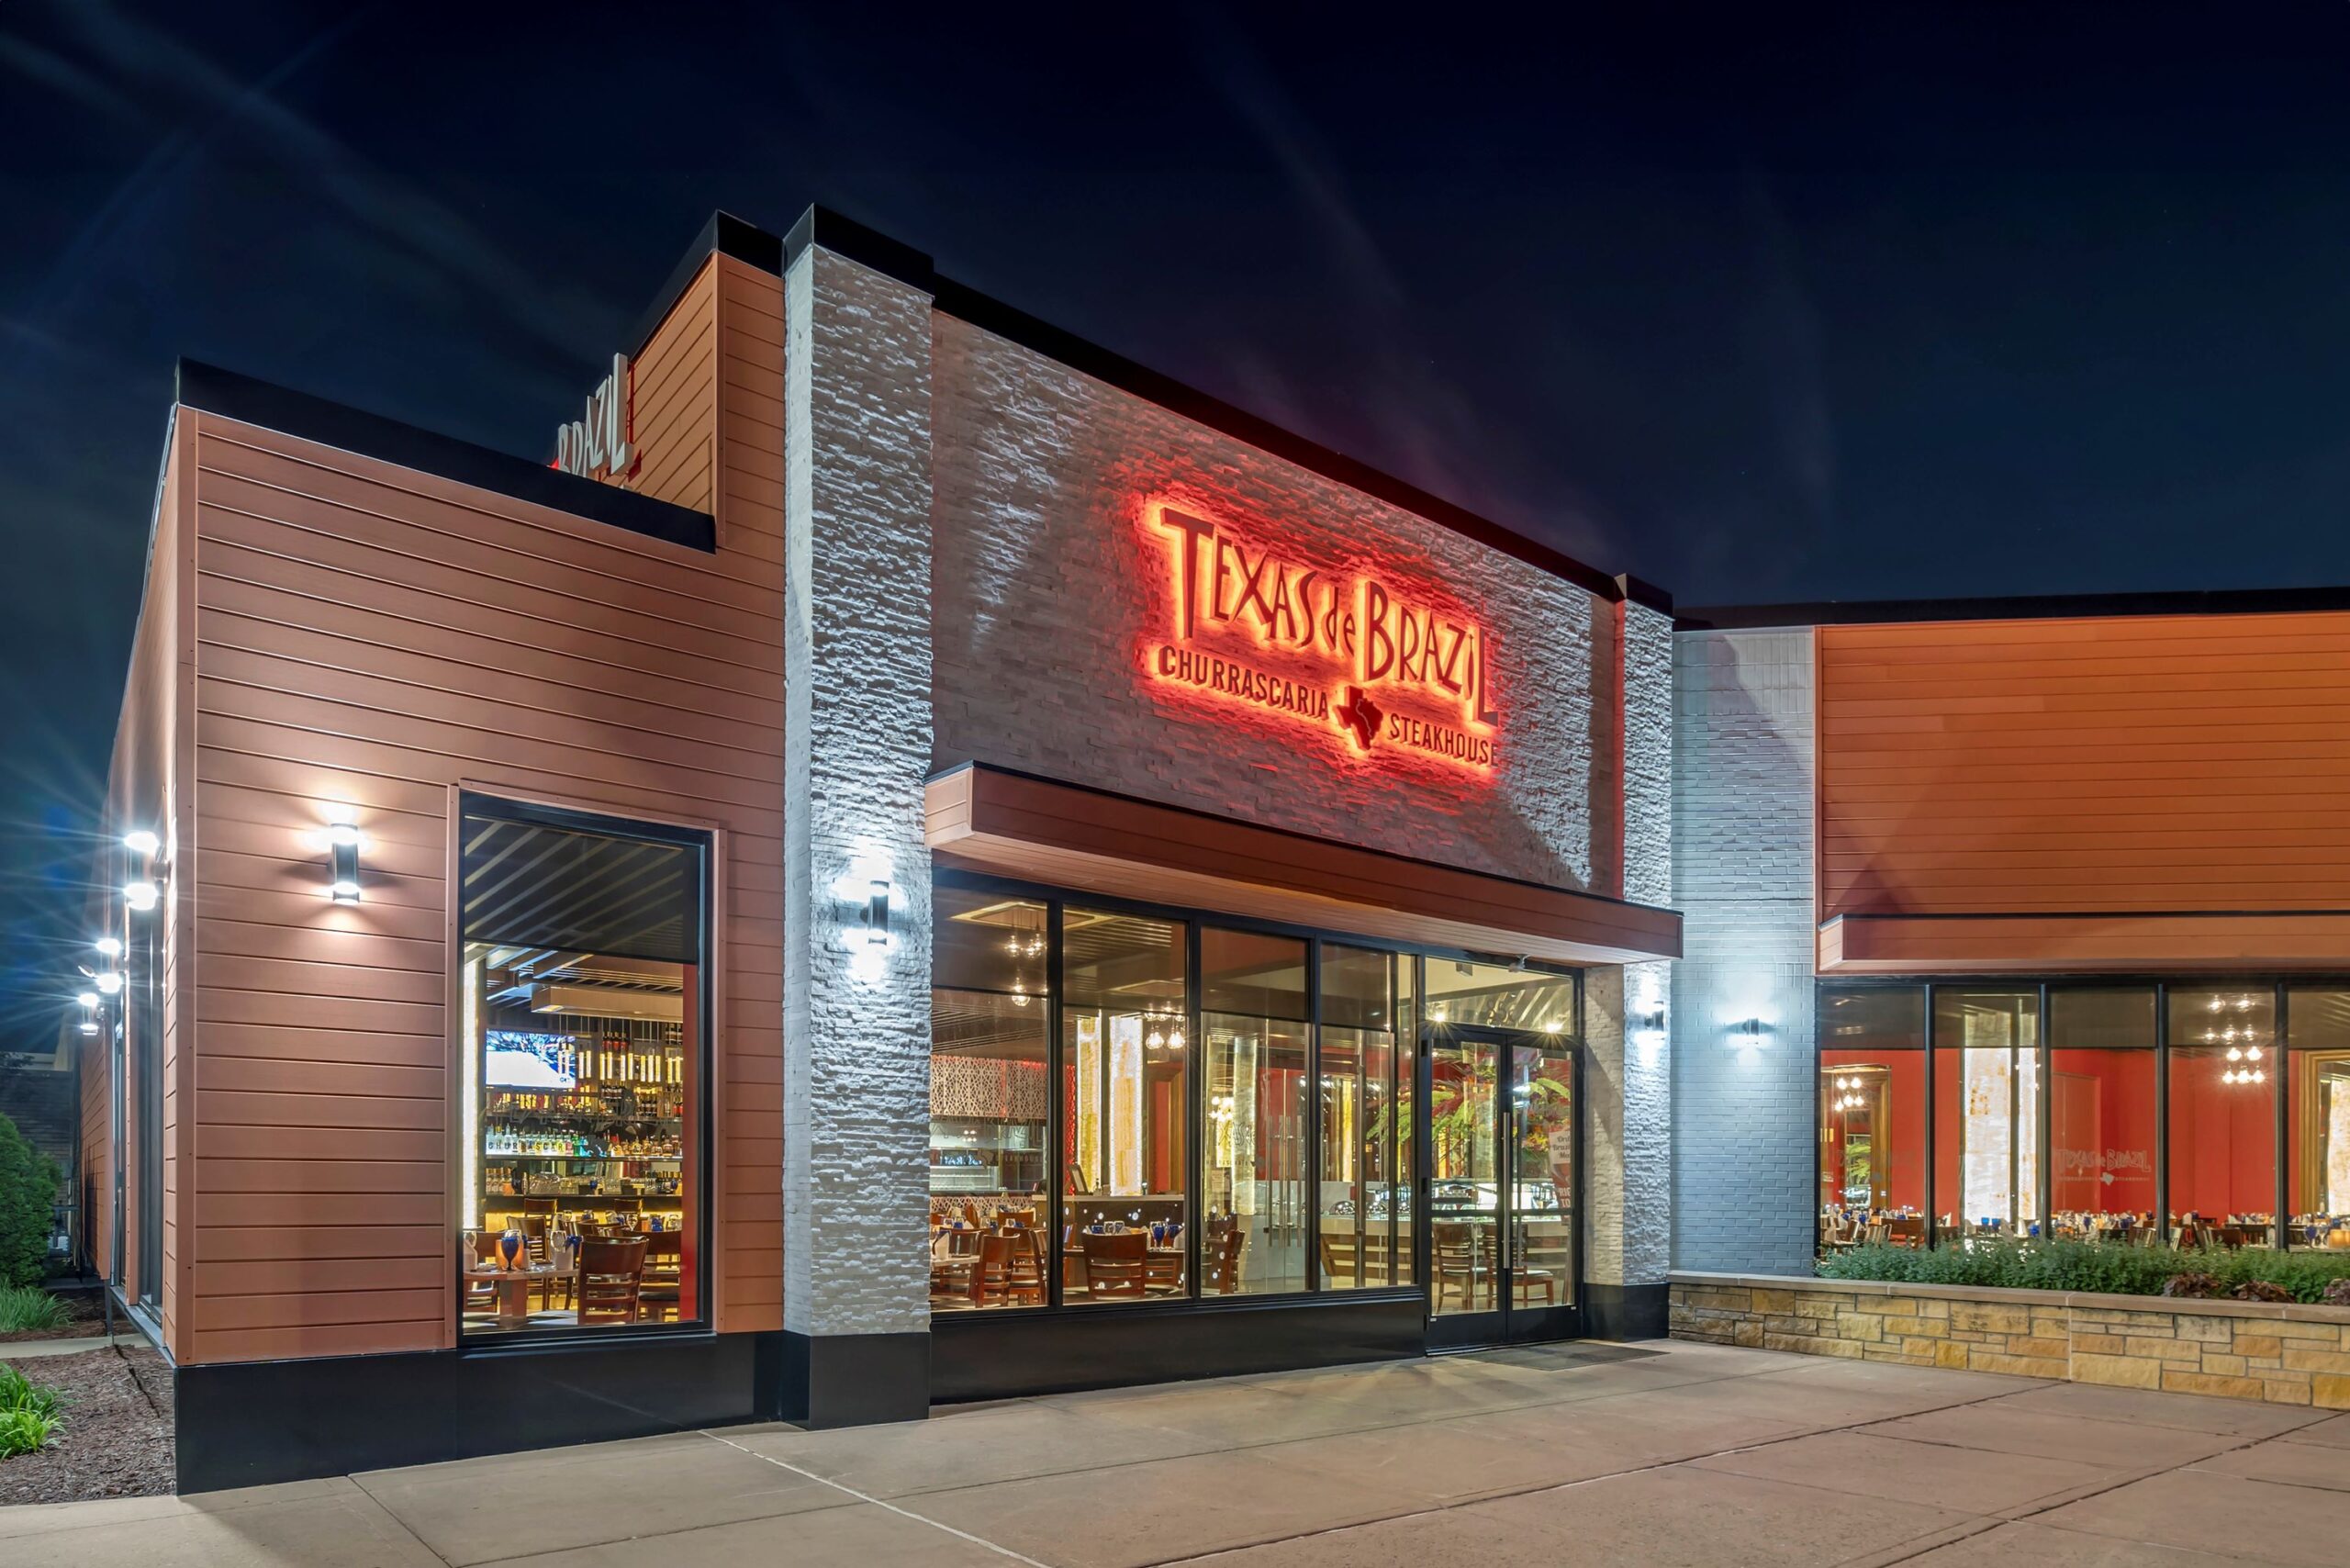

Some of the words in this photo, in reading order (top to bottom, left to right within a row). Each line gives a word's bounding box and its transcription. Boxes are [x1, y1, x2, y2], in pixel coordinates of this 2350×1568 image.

[1159, 507, 1317, 649] TEXAS
[1324, 586, 1356, 655] de
[1365, 580, 1499, 727] BRAZIL
[1158, 645, 1330, 721] CHURRASCARIA
[1389, 712, 1499, 767] STEAKHOUSE
